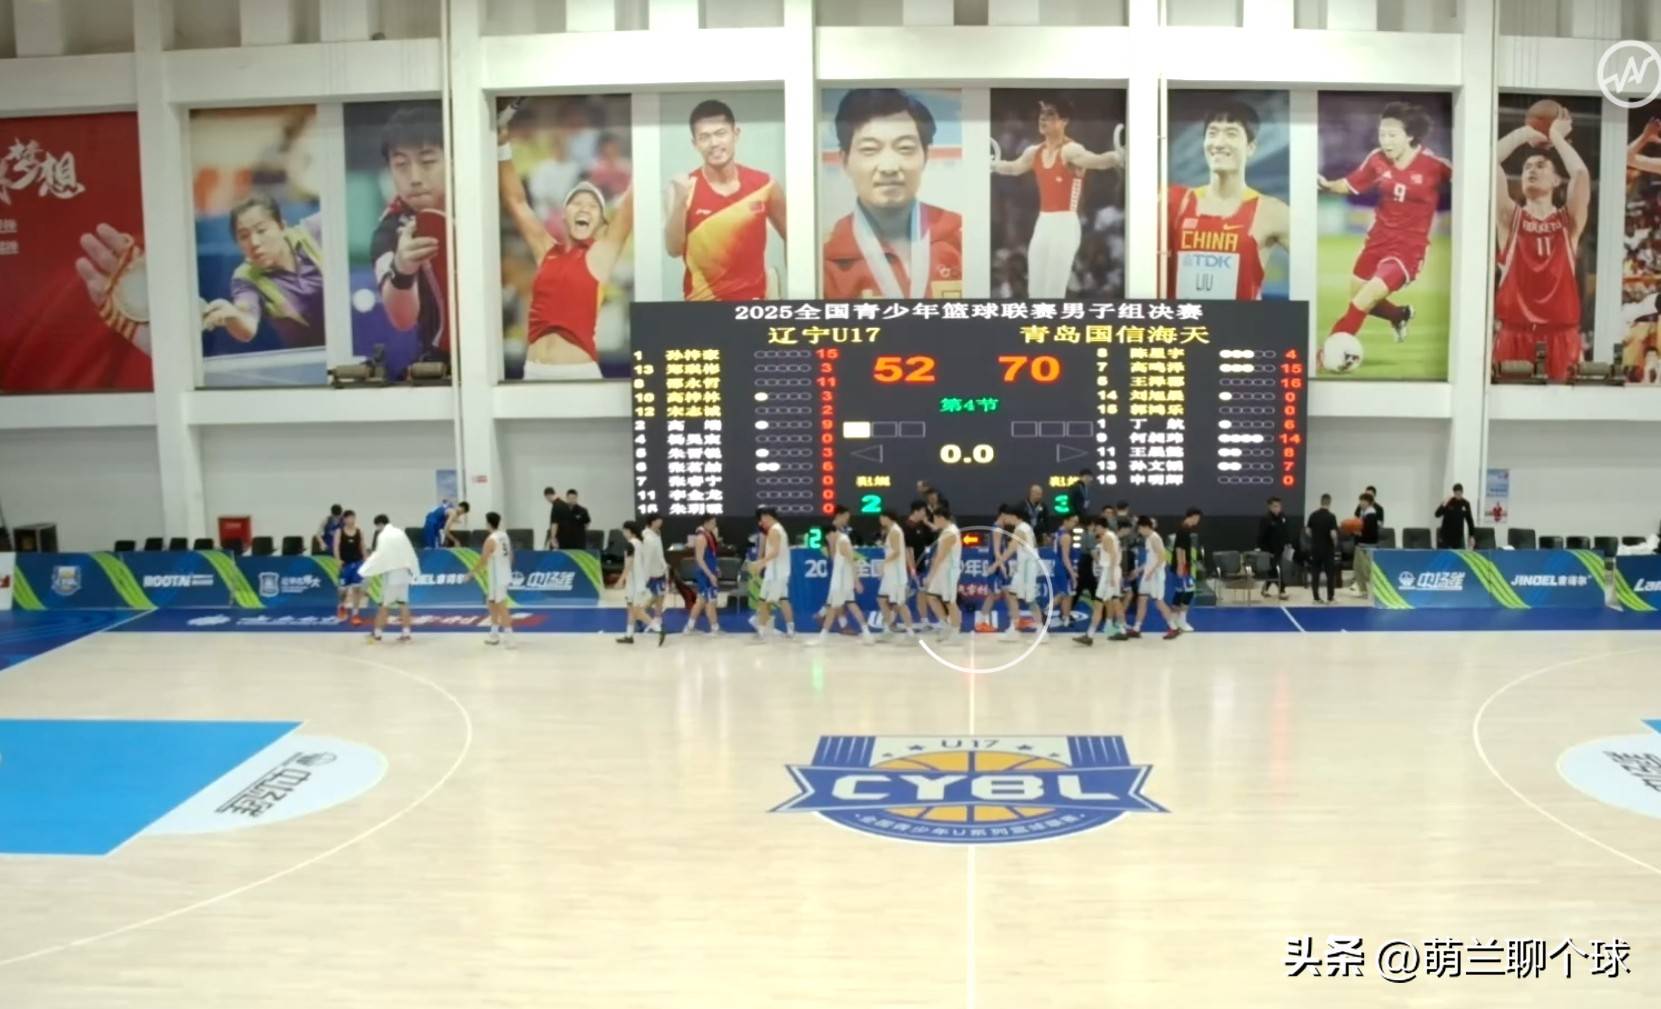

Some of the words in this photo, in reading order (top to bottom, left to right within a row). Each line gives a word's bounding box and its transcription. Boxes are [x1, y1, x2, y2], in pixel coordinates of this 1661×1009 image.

[1394, 183, 1406, 202] 9
[1181, 230, 1238, 251] CHINA
[1537, 237, 1550, 256] 11
[1194, 254, 1231, 268] TDK
[734, 303, 1203, 321] 2025全国青少年篮球联赛男子组决赛
[1020, 324, 1210, 345] 青岛国信海天
[634, 351, 642, 360] 1
[816, 348, 839, 360] 15
[1285, 350, 1297, 359] 4
[634, 365, 654, 375] 13
[821, 362, 833, 374] 3
[873, 355, 936, 384] 52
[998, 355, 1061, 384] 70
[1097, 362, 1107, 371] 7
[1281, 363, 1302, 375] 15
[816, 376, 837, 388] 11
[1281, 378, 1302, 388] 16
[822, 391, 833, 402] 3
[1098, 390, 1117, 400] 14
[1285, 392, 1295, 402] 0
[822, 405, 833, 416] 2
[939, 397, 1000, 413] 第4节
[1285, 405, 1295, 416] 0
[635, 406, 655, 417] 12
[822, 419, 833, 431] 9
[1098, 419, 1105, 428] 1
[1284, 419, 1295, 430] 6
[635, 434, 646, 444] 4
[822, 433, 833, 445] 0
[1280, 434, 1301, 444] 14
[823, 447, 834, 458] 3
[940, 444, 995, 464] 0.0
[1097, 447, 1115, 456] 11
[823, 460, 834, 473] 6
[1097, 461, 1116, 470] 13
[1284, 461, 1294, 471] 7
[636, 476, 647, 486] 7
[822, 475, 834, 487] 0
[1283, 475, 1294, 485] 0
[638, 490, 655, 500] 11
[823, 488, 834, 500] 0
[823, 502, 834, 514] 0
[861, 495, 882, 513] 2
[1054, 495, 1070, 513] 3
[832, 774, 1119, 800] CYBL
